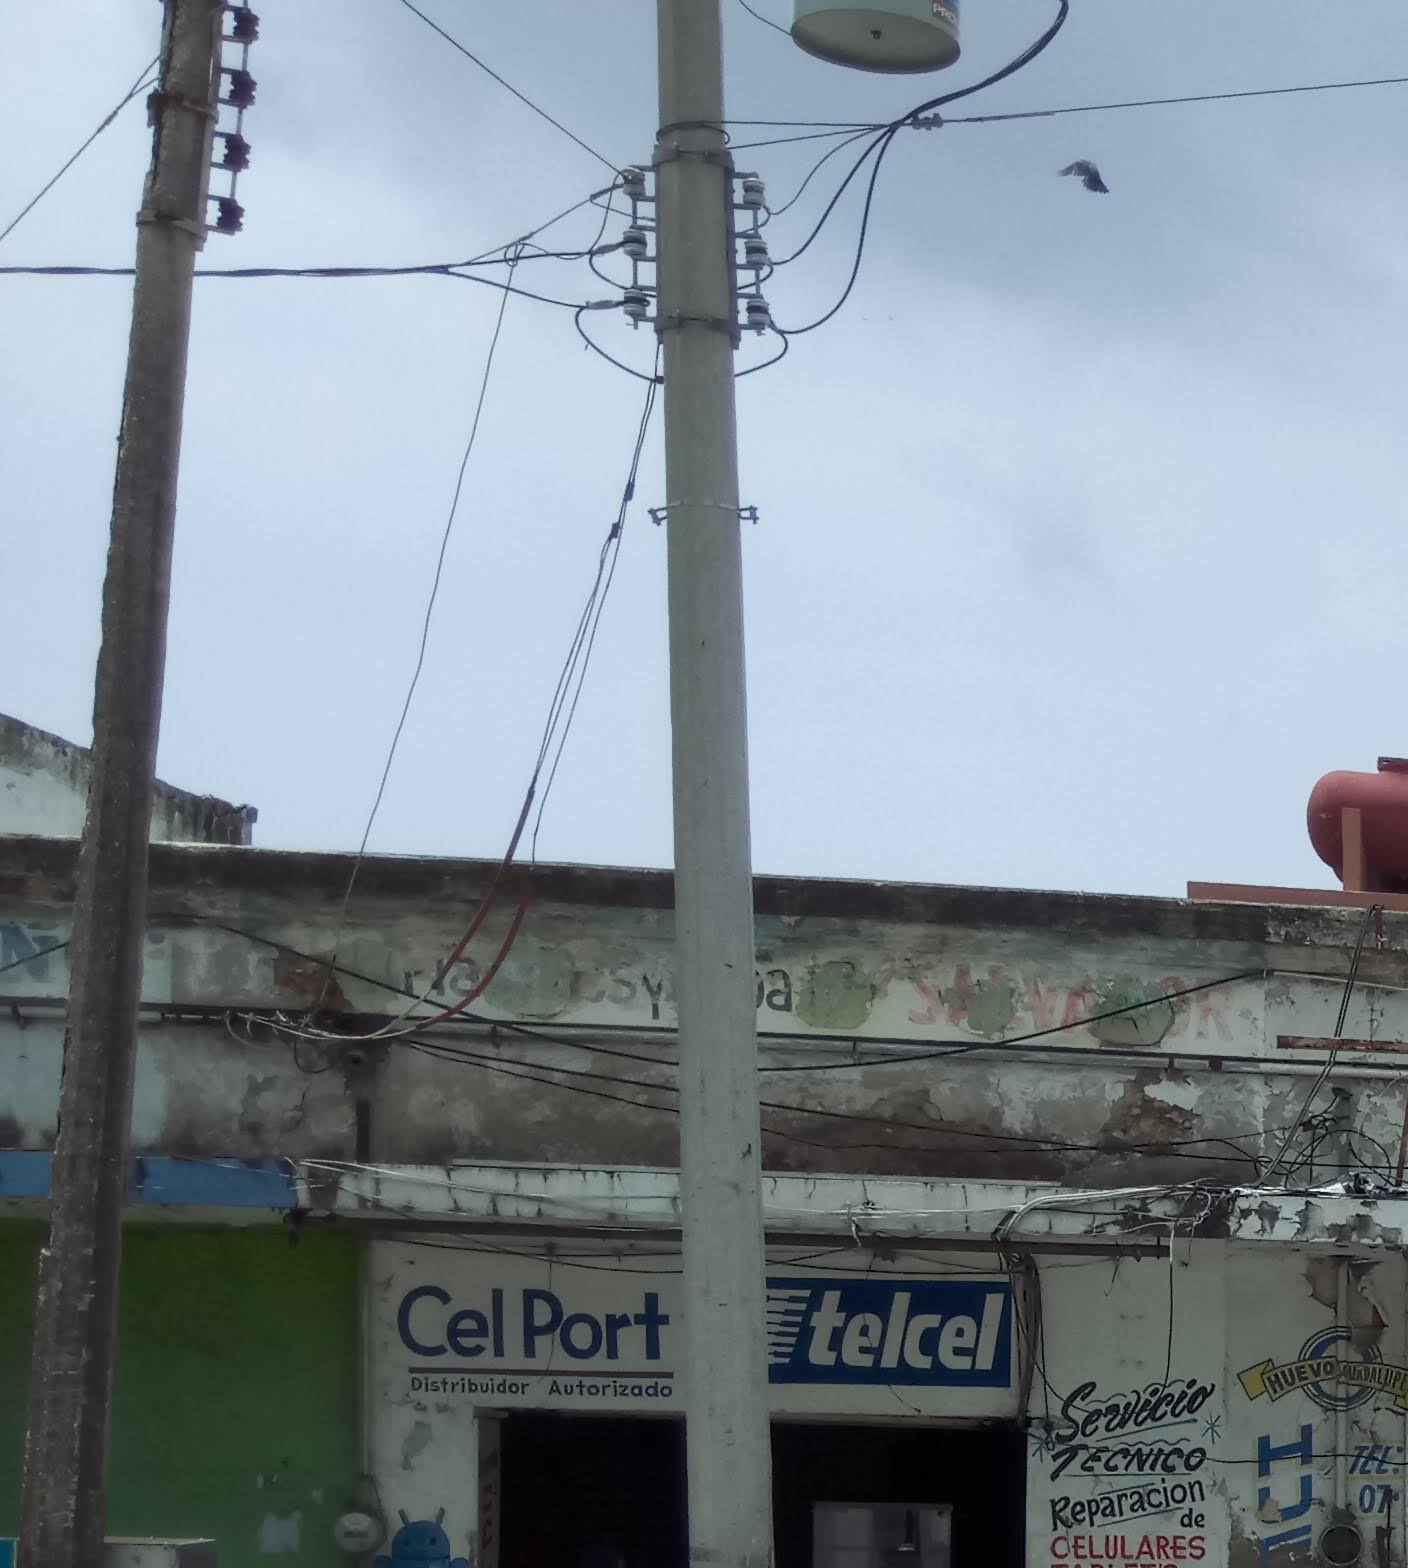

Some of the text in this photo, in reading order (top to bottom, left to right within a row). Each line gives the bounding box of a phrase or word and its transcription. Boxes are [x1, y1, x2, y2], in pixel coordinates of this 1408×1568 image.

[808, 1290, 1004, 1370] telcel
[411, 1376, 673, 1398] Distribuidor Autorizado
[1055, 1378, 1215, 1443] Servicio
[1050, 1478, 1206, 1531] Reparacion
[1180, 1508, 1205, 1528] de
[1050, 1535, 1206, 1560] CELULARES
